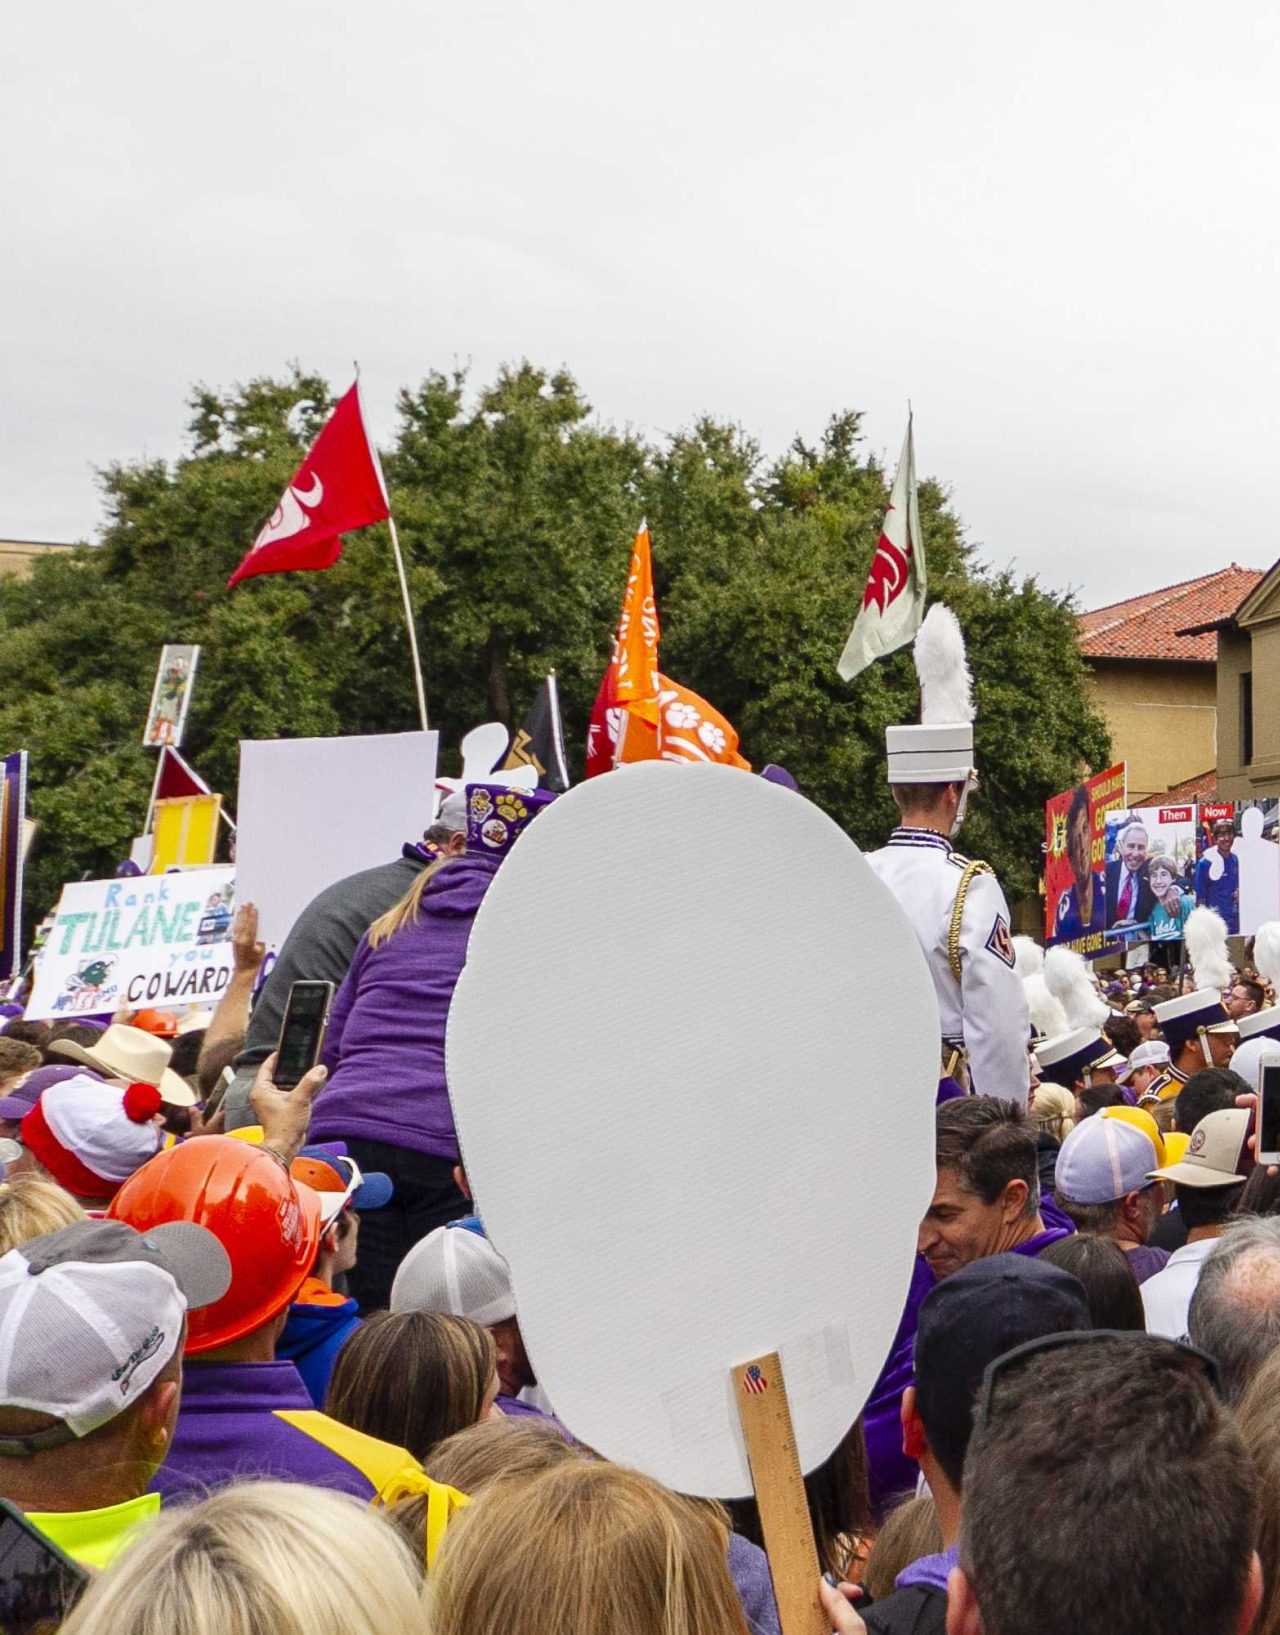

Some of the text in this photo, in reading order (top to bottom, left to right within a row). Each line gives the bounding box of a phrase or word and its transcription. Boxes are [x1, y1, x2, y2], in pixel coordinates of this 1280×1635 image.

[1162, 810, 1187, 820] Then
[1204, 807, 1227, 817] Now
[105, 879, 169, 908] Rank
[58, 901, 201, 956] TULANE
[169, 949, 214, 967] you
